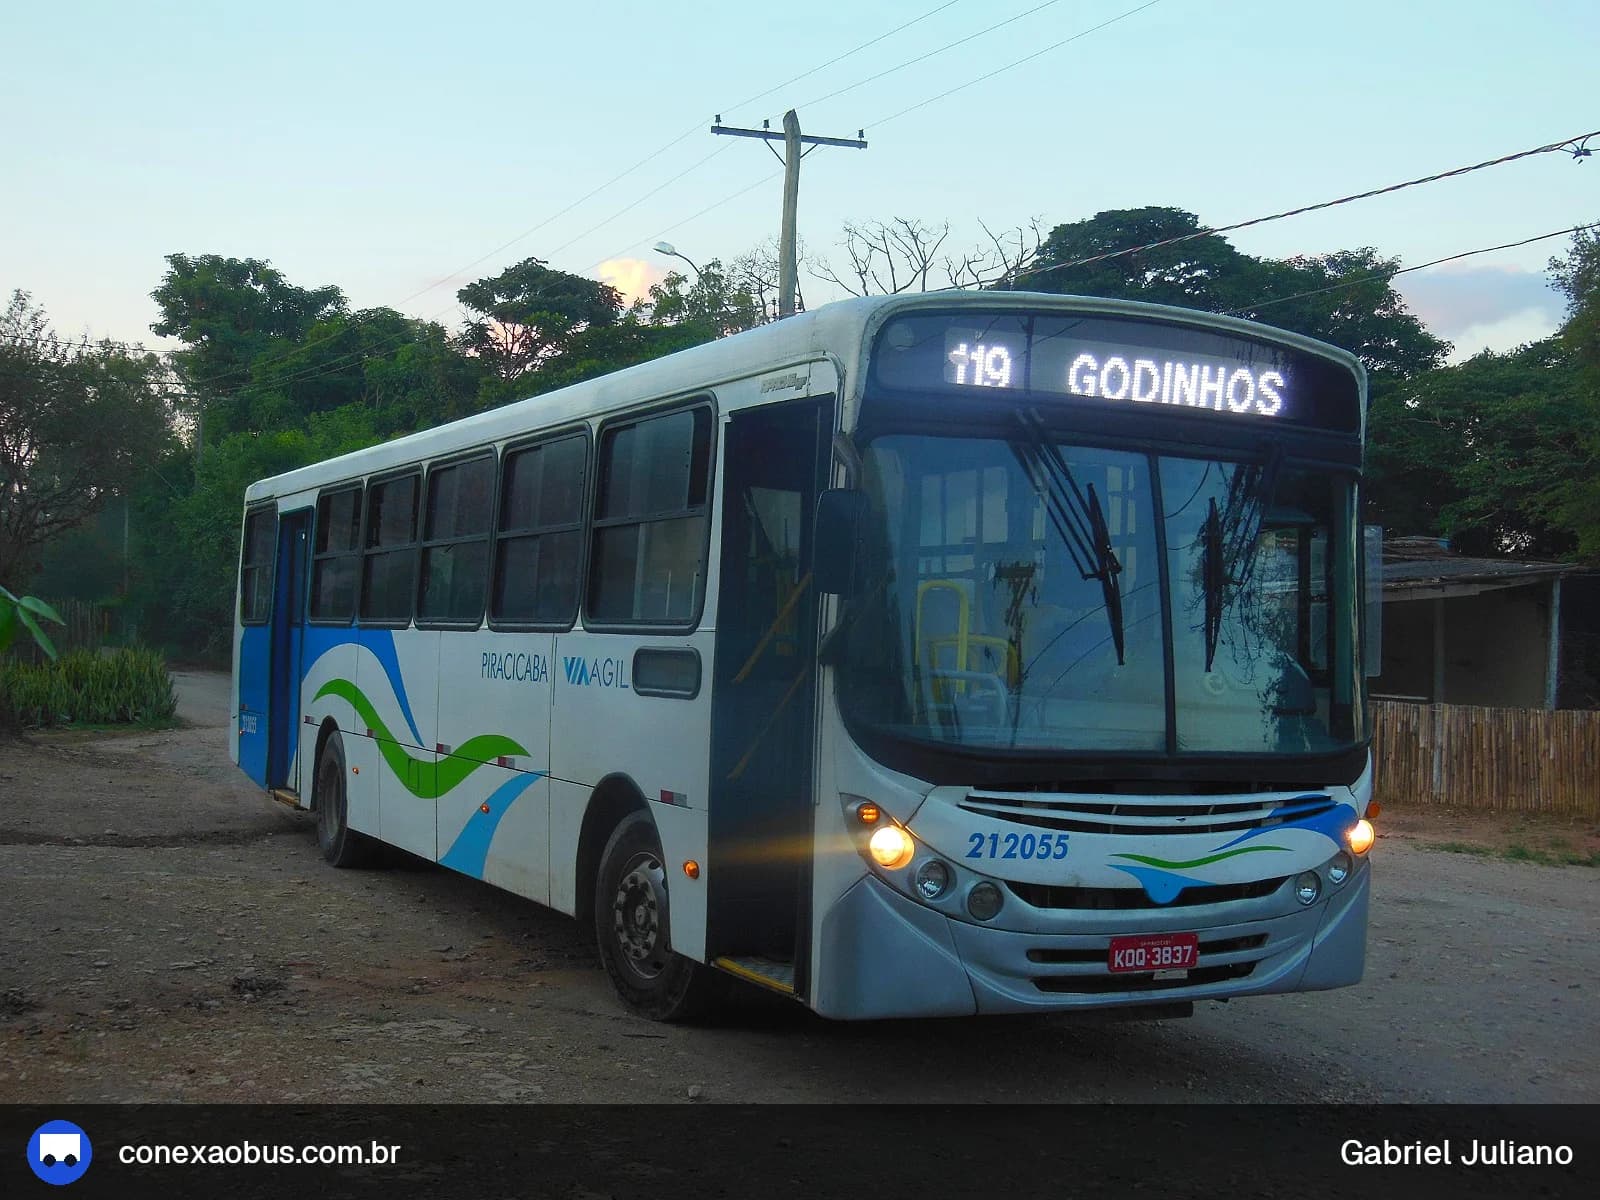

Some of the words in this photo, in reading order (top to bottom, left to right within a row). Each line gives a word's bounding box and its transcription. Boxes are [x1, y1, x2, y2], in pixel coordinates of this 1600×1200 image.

[949, 342, 1011, 387] 119
[1069, 354, 1284, 415] GODINHOS
[482, 652, 548, 682] PIRACICABA
[965, 832, 1070, 859] 212055
